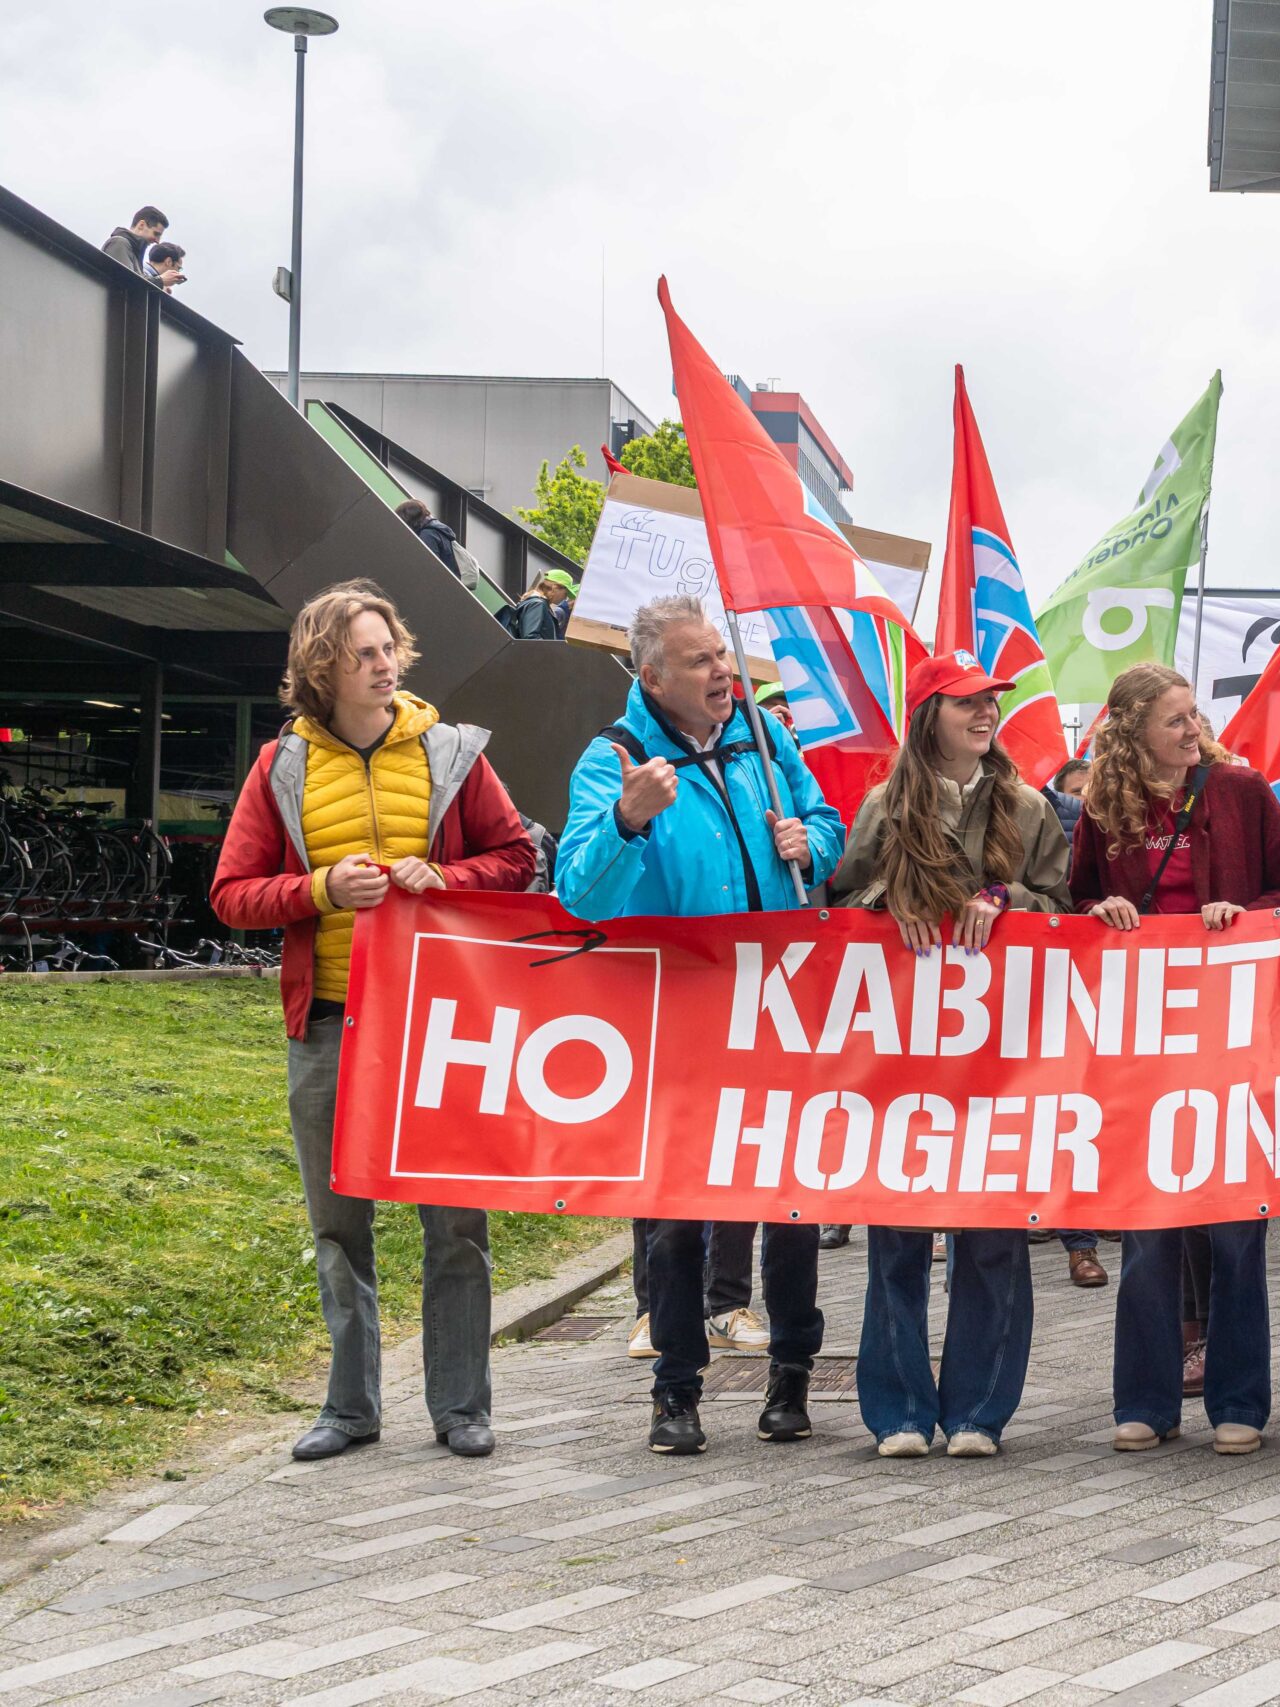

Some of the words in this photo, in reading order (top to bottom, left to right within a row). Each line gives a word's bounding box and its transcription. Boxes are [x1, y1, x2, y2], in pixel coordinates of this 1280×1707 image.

[728, 938, 1280, 1057] KABINET
[415, 997, 634, 1124] HO
[707, 1087, 1103, 1194] HOGER
